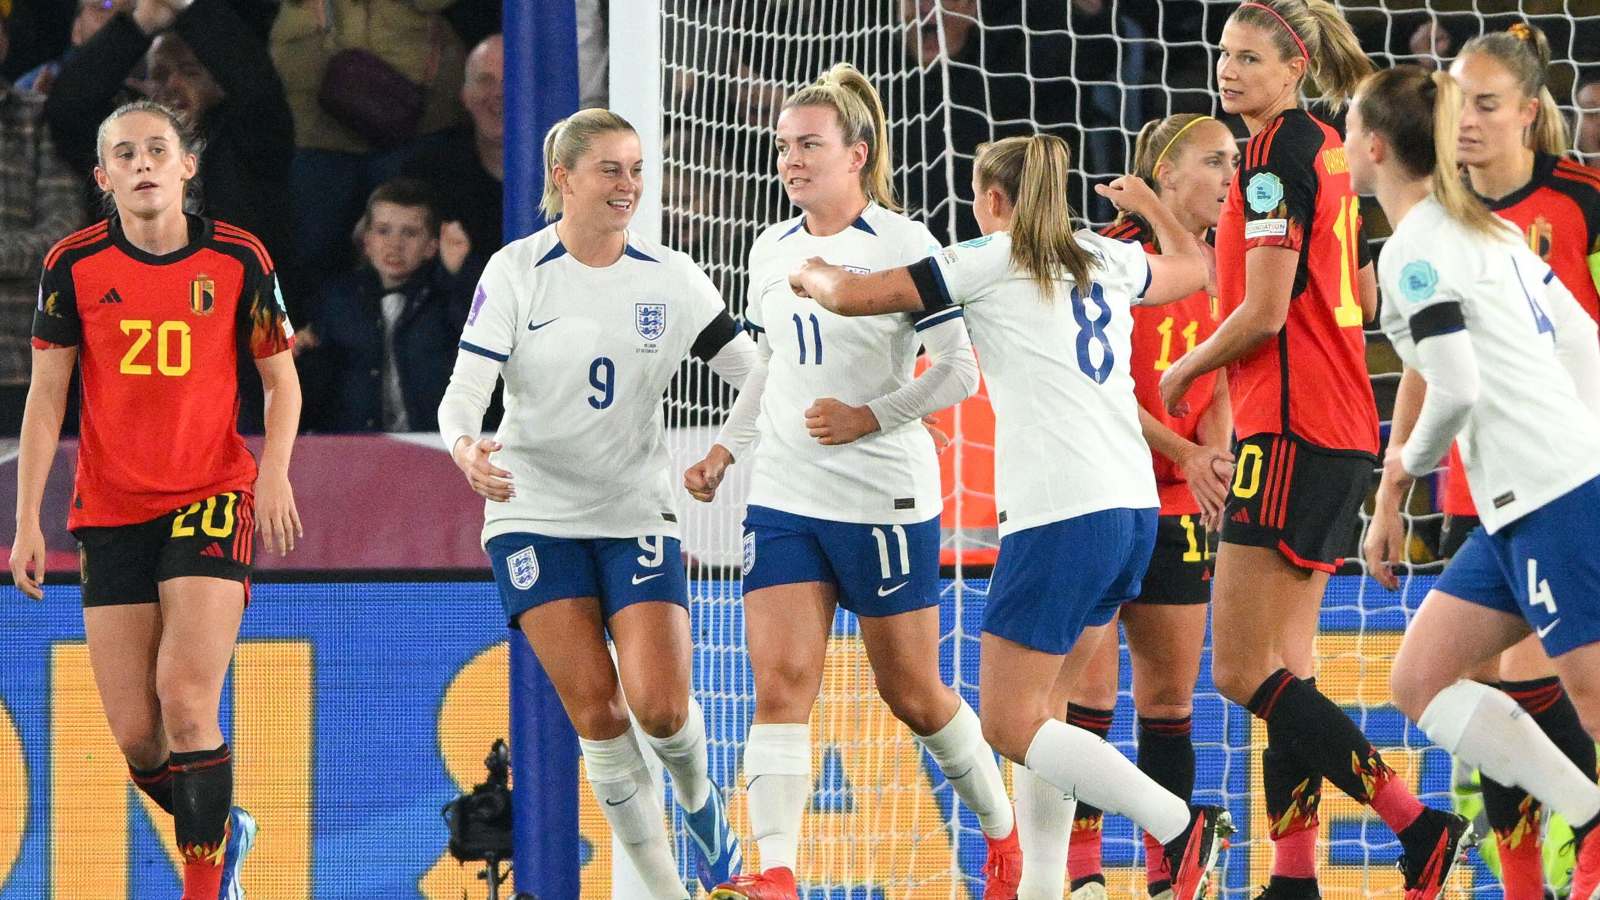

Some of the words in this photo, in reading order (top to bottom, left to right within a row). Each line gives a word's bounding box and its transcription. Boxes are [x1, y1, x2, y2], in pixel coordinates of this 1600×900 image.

[1511, 253, 1557, 343] 4
[119, 319, 192, 376] 20
[792, 312, 823, 365] 11
[1071, 281, 1115, 384] 8
[1154, 317, 1199, 372] 11
[588, 356, 615, 410] 9
[171, 492, 236, 537] 20
[636, 535, 664, 568] 9
[871, 524, 911, 579] 11
[1528, 558, 1557, 613] 4
[0, 642, 313, 900] N
